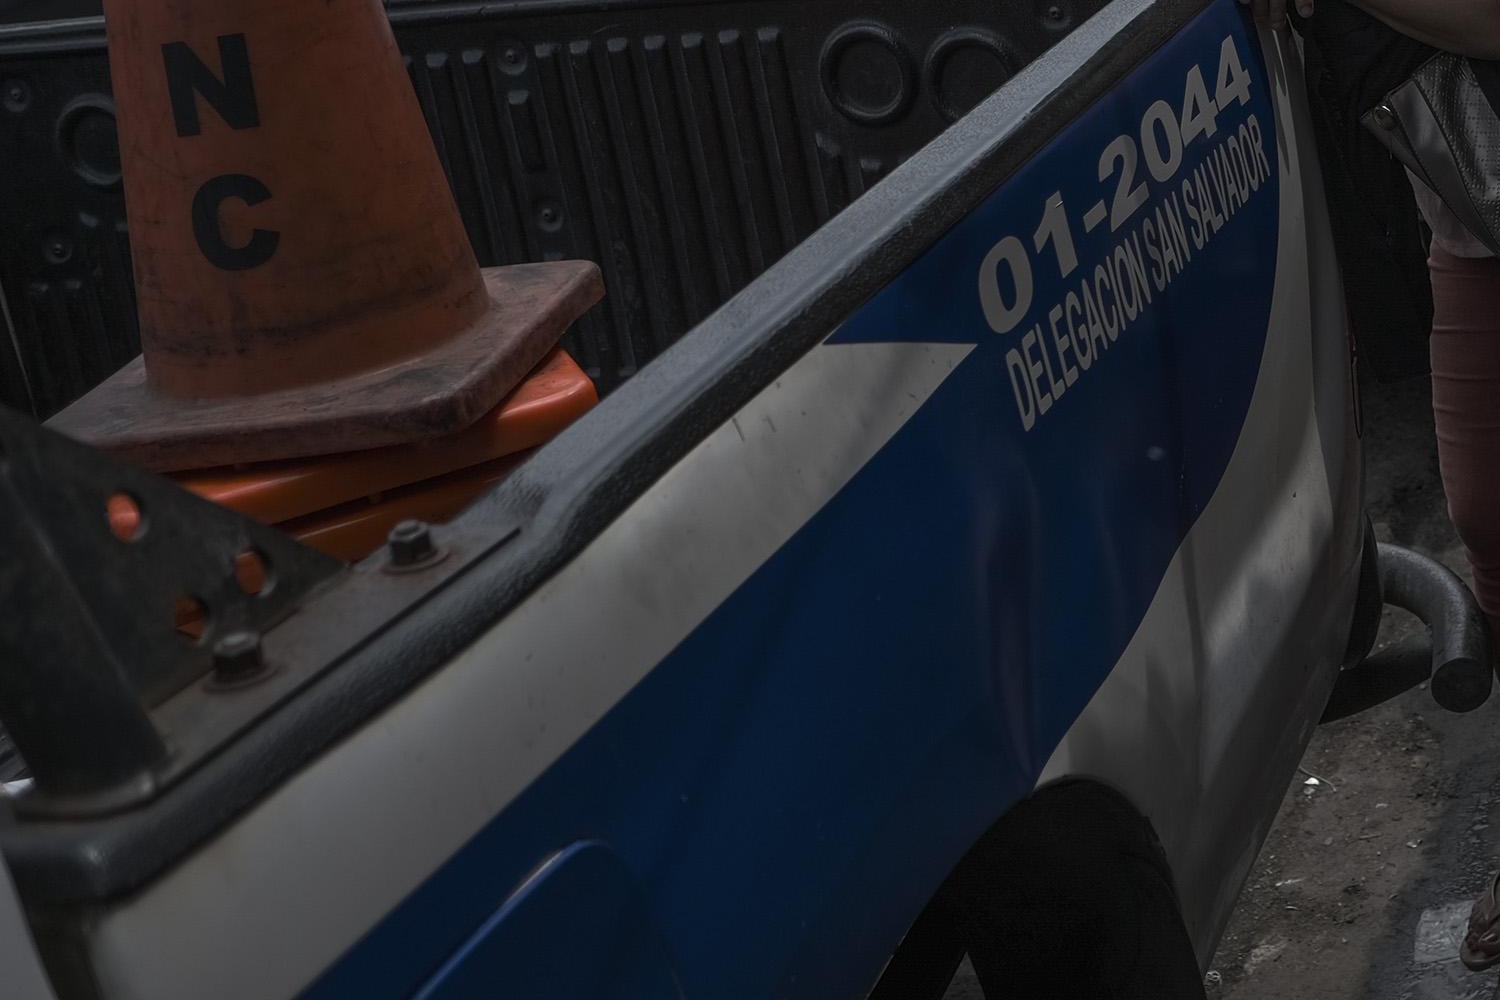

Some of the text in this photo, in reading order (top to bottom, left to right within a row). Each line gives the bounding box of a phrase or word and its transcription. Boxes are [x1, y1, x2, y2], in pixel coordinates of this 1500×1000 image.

[978, 34, 1251, 334] 01-2044
[1006, 114, 1270, 432] DELEGACION SAN SALVADOR
